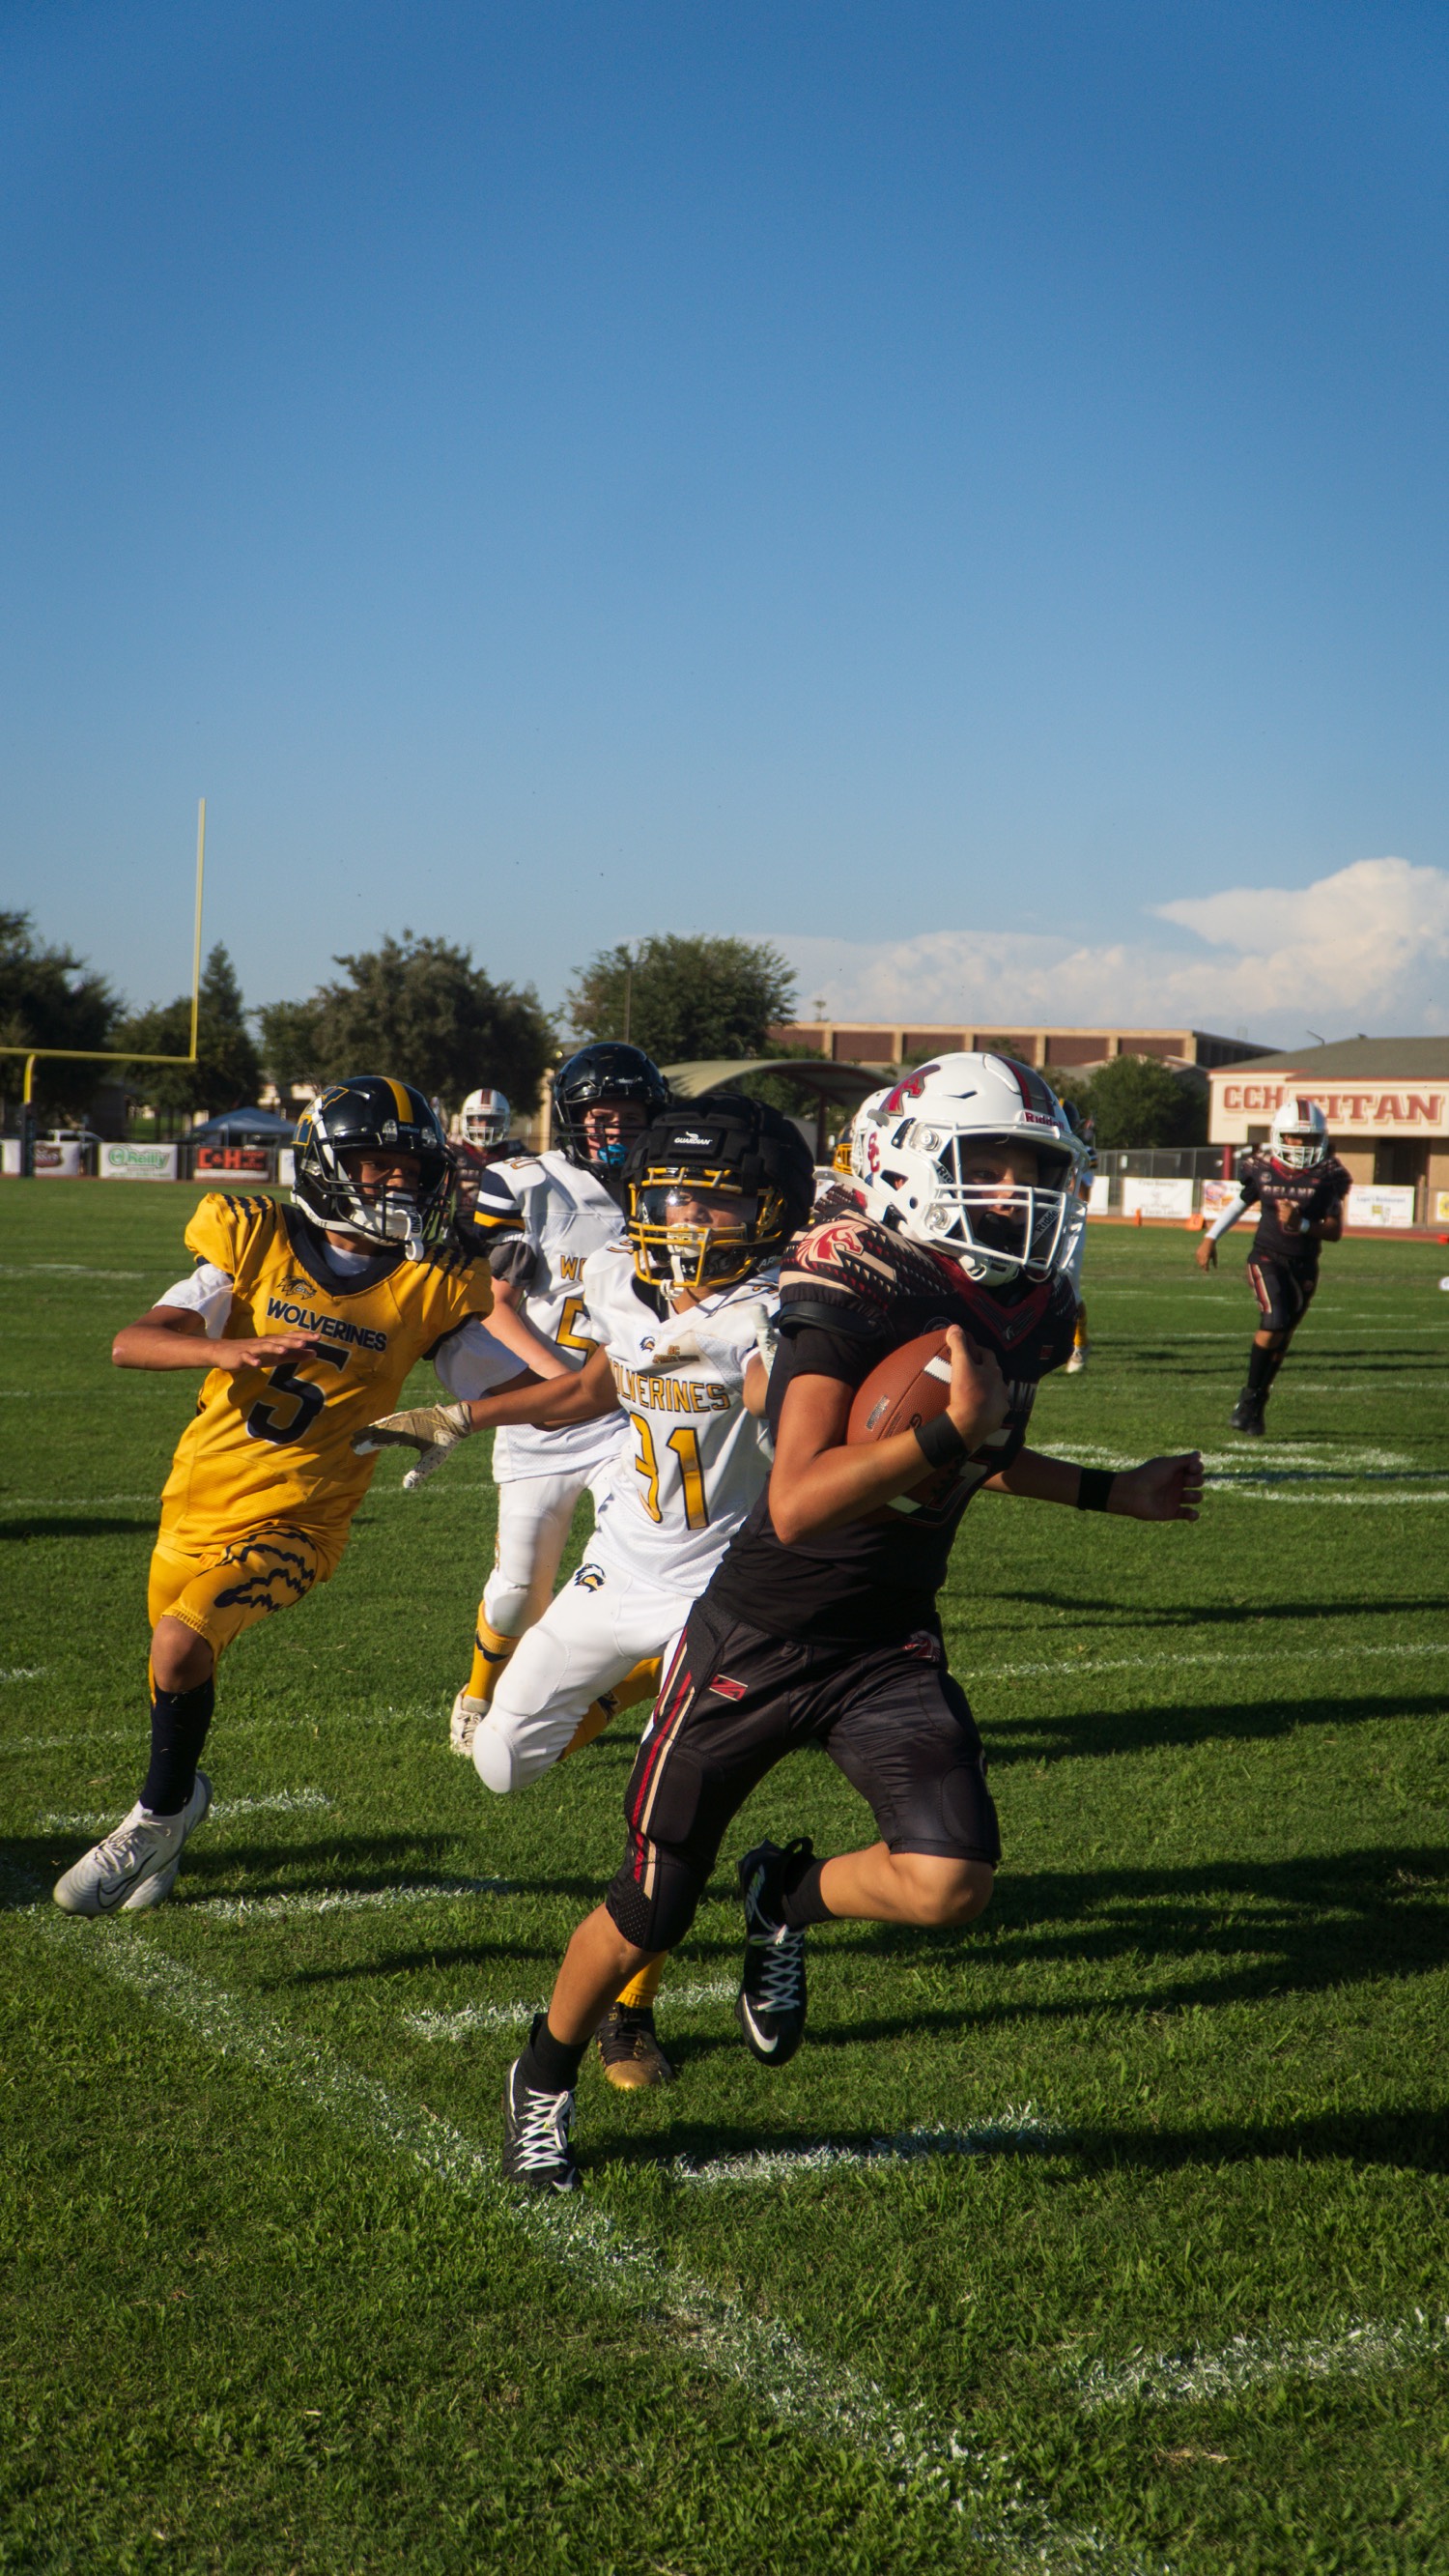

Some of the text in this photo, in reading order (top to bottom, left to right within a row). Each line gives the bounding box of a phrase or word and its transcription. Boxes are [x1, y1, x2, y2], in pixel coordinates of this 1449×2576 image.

[674, 1136, 711, 1145] GUARDIAN
[267, 1297, 387, 1353] WOLVERINES
[246, 1340, 352, 1445] 5
[609, 1358, 731, 1413] OLVERINES
